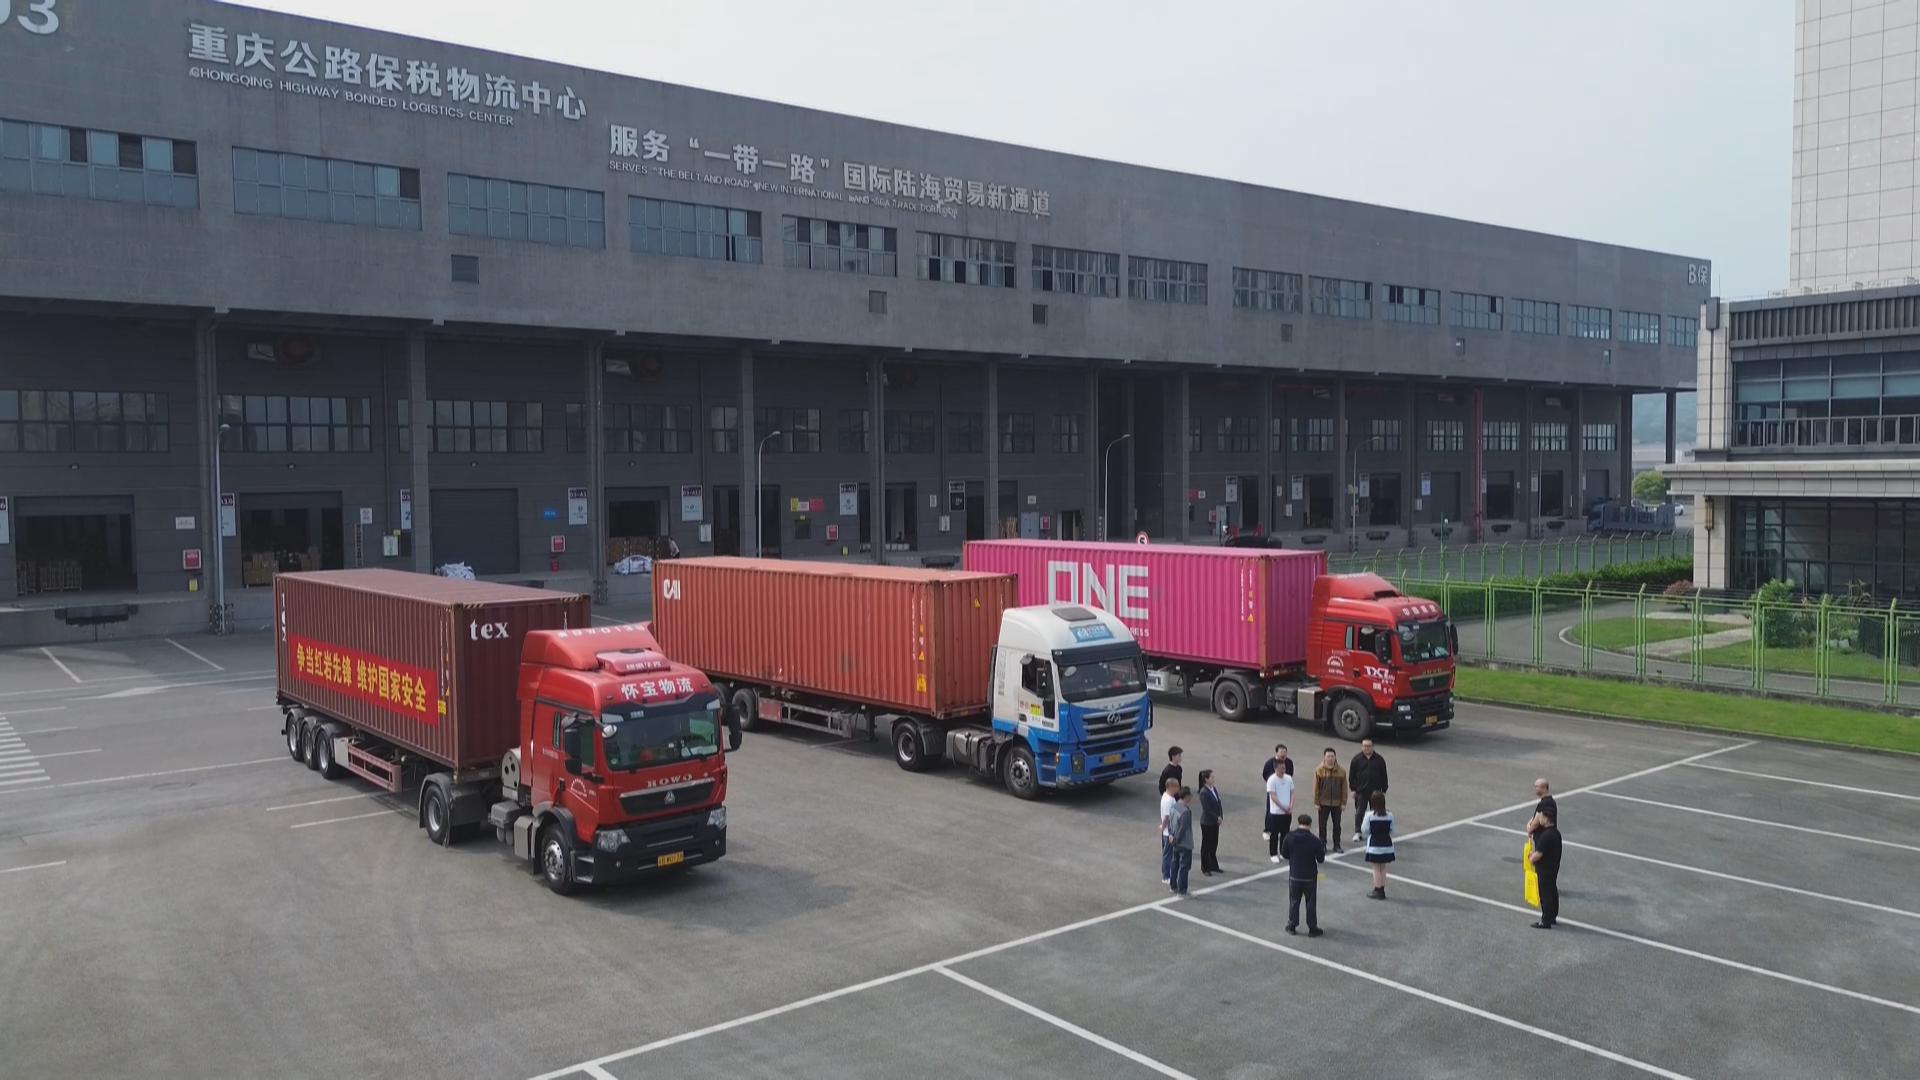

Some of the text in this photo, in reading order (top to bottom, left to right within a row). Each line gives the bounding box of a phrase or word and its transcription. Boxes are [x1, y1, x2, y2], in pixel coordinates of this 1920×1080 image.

[188, 23, 587, 121] 重庆公路保税物流中心
[280, 80, 340, 99] HIGHWAY
[345, 91, 397, 109] BONDED
[402, 101, 464, 118] LOGISTICS
[469, 110, 514, 126] CENTER
[609, 160, 648, 175] SERVES
[678, 169, 701, 182] BELT
[703, 174, 722, 185] AND
[780, 184, 842, 201] INTERNATIONAL
[610, 124, 670, 162] 服务
[843, 160, 1051, 218] 国际陆海贸易新通道
[1048, 560, 1149, 620] ONE
[470, 618, 509, 641] tex
[296, 642, 352, 687] 争当红岩先锋
[356, 658, 427, 713] 维护国家安全
[621, 677, 694, 700] 怀宝物流
[647, 773, 693, 788] HOWO
